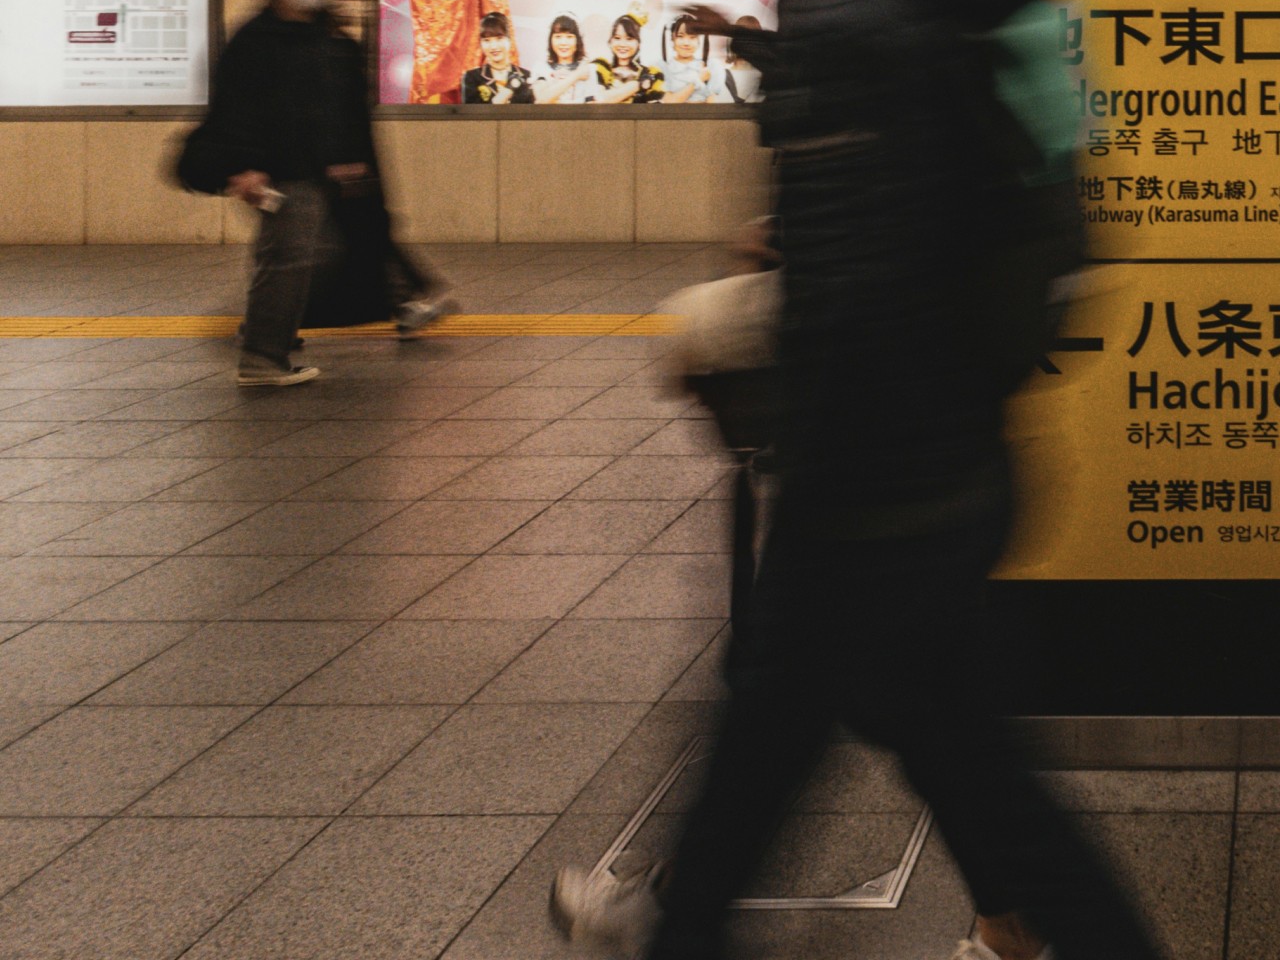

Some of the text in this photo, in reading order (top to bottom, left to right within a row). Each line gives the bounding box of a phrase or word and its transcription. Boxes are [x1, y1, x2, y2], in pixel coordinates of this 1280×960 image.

[1084, 127, 1209, 158] 동쪽 출구
[1147, 204, 1239, 226] (Karasuma
[1125, 421, 1213, 450] 하치조
[1221, 421, 1280, 450] 동쪽
[1127, 479, 1272, 513] 営業時間
[1126, 520, 1204, 550] Open
